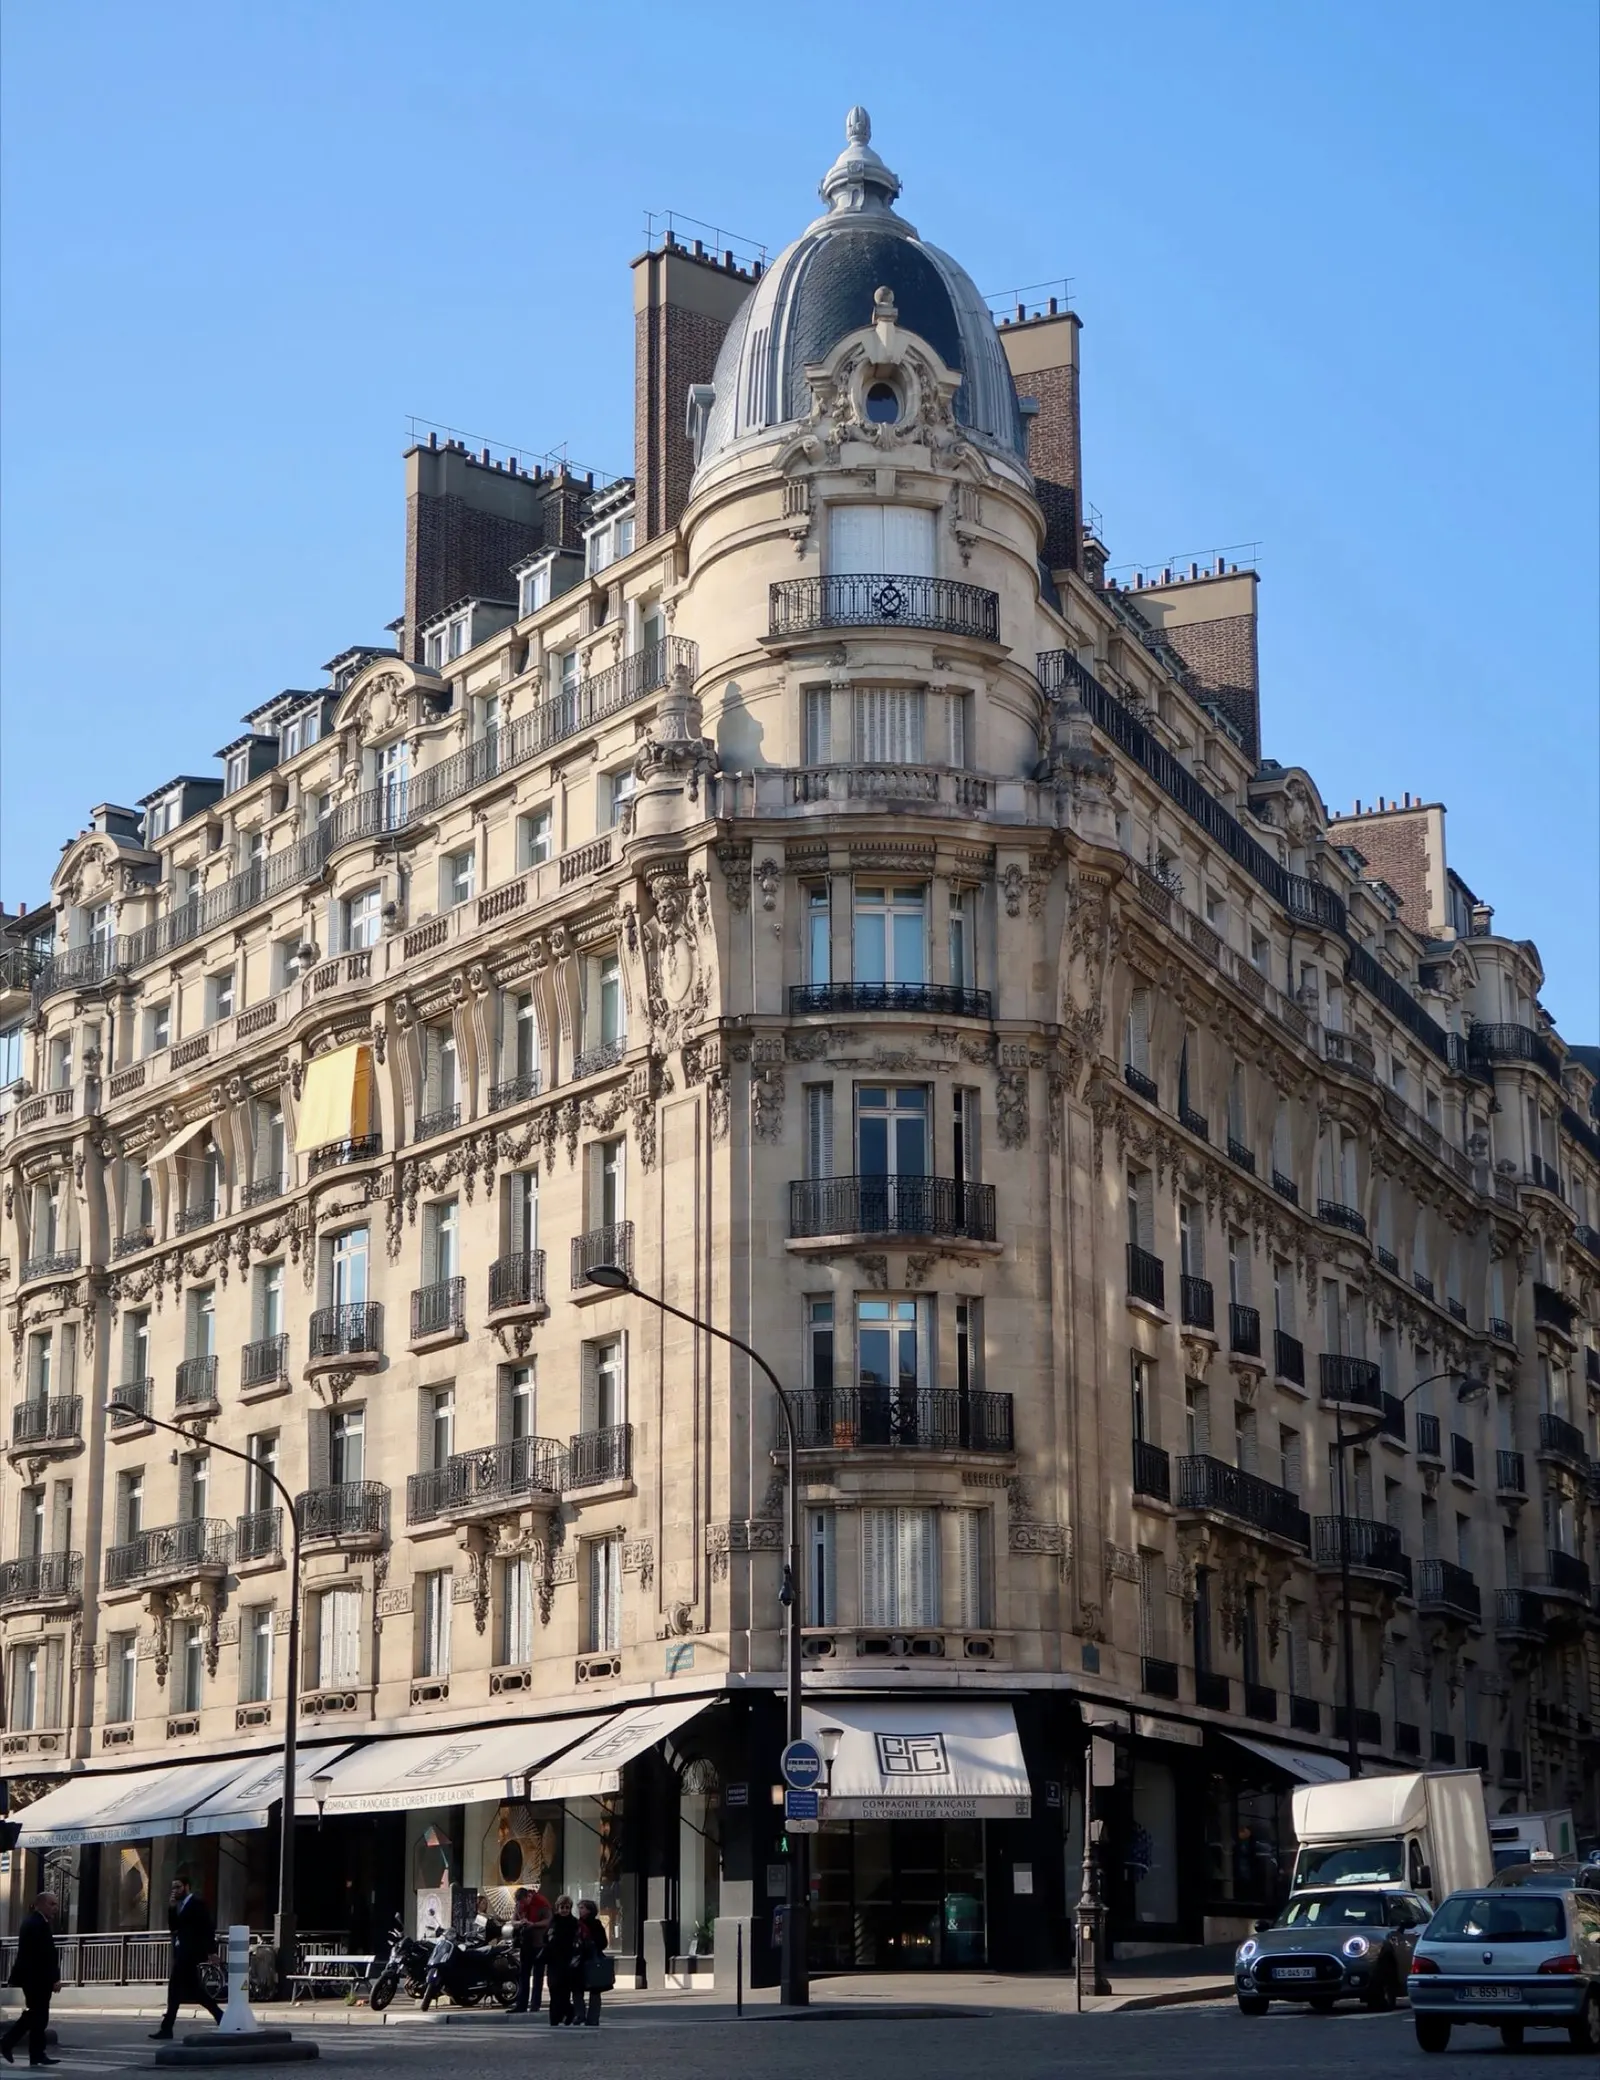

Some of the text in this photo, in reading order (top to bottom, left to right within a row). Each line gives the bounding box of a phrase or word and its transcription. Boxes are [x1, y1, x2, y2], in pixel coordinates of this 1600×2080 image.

[324, 1789, 475, 1811] COMPAGNIE FRANÇAISE DE L'ORIENT ET DE LA CHINE
[863, 1800, 977, 1810] COMPAGNIE FRANÇAISE
[863, 1810, 977, 1818] DE L'ORIENT ET DE LA CHINE
